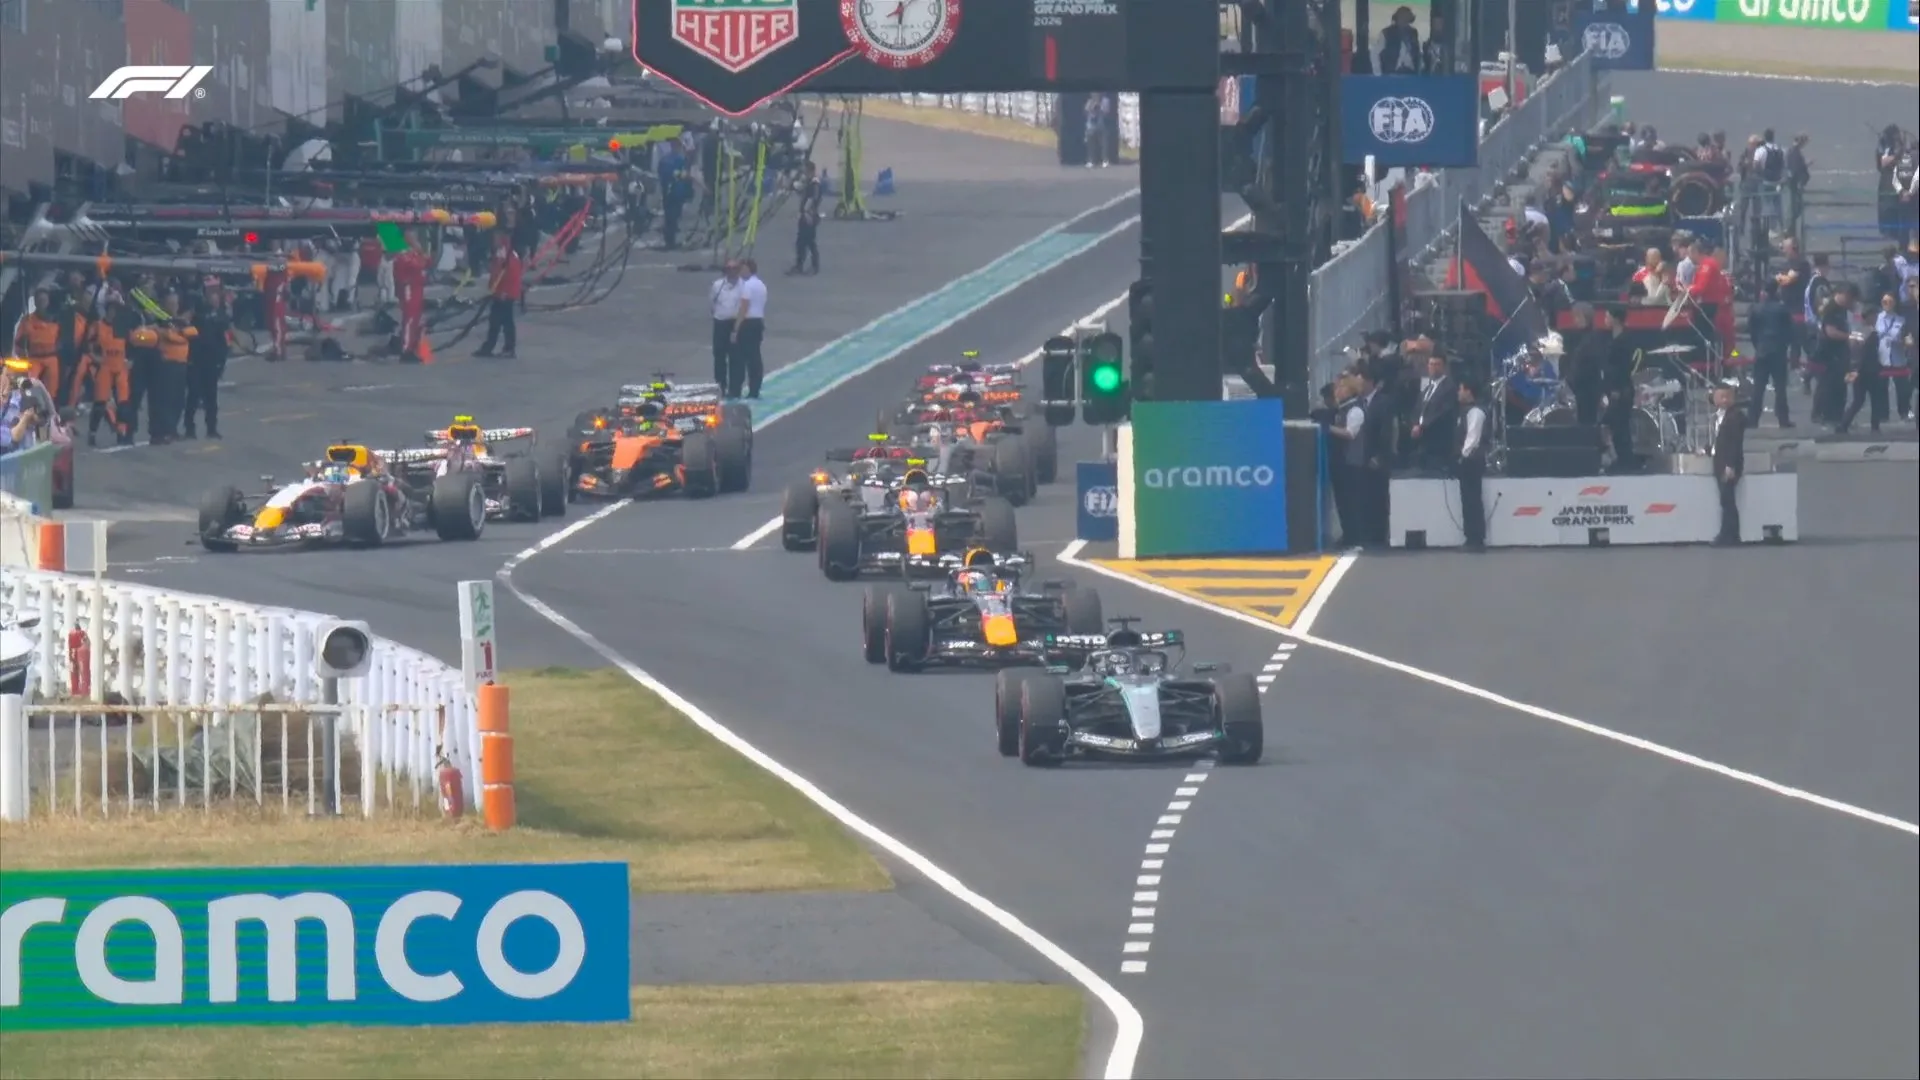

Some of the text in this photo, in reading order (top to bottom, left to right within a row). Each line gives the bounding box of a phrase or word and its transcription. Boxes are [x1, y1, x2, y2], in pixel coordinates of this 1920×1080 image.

[1034, 4, 1117, 14] GRAND PRIX
[1034, 17, 1062, 26] 2026
[680, 14, 789, 62] HEUER
[1144, 465, 1274, 488] aramco
[1558, 505, 1629, 516] JAPANESE
[1552, 516, 1635, 526] GRAND PRIX
[0, 890, 586, 1006] ramco
